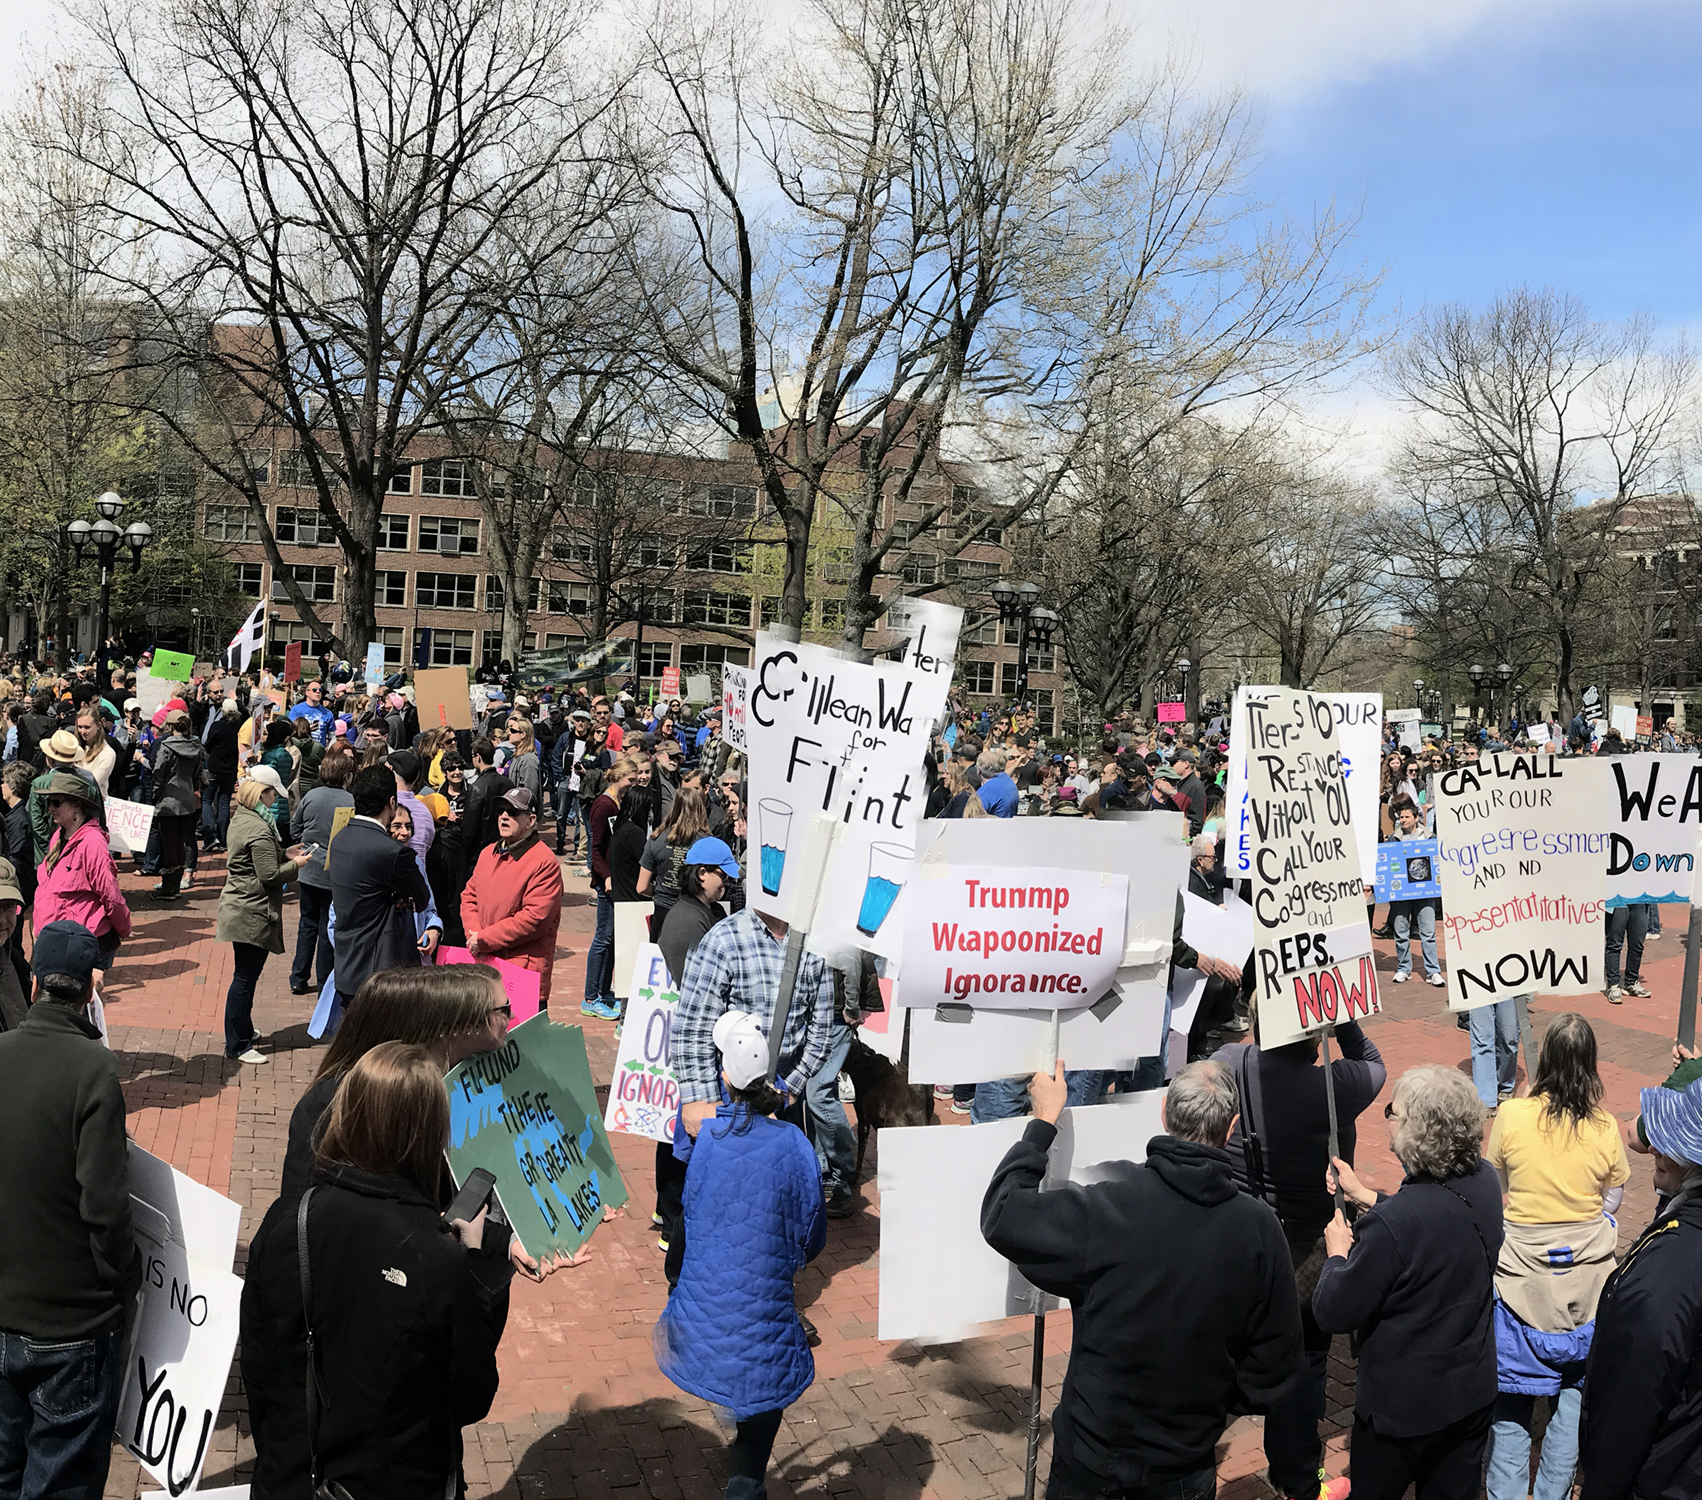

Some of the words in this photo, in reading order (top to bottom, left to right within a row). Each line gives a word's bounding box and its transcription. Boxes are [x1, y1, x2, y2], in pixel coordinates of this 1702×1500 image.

[1610, 761, 1677, 823] We
[1255, 845, 1309, 886] CALL
[1301, 829, 1346, 864] YOUR
[1473, 863, 1506, 890] AND
[1605, 832, 1695, 876] Down
[1258, 932, 1335, 1000] REPS.
[1292, 955, 1380, 1029] NOW!
[128, 1354, 213, 1498] YOU
